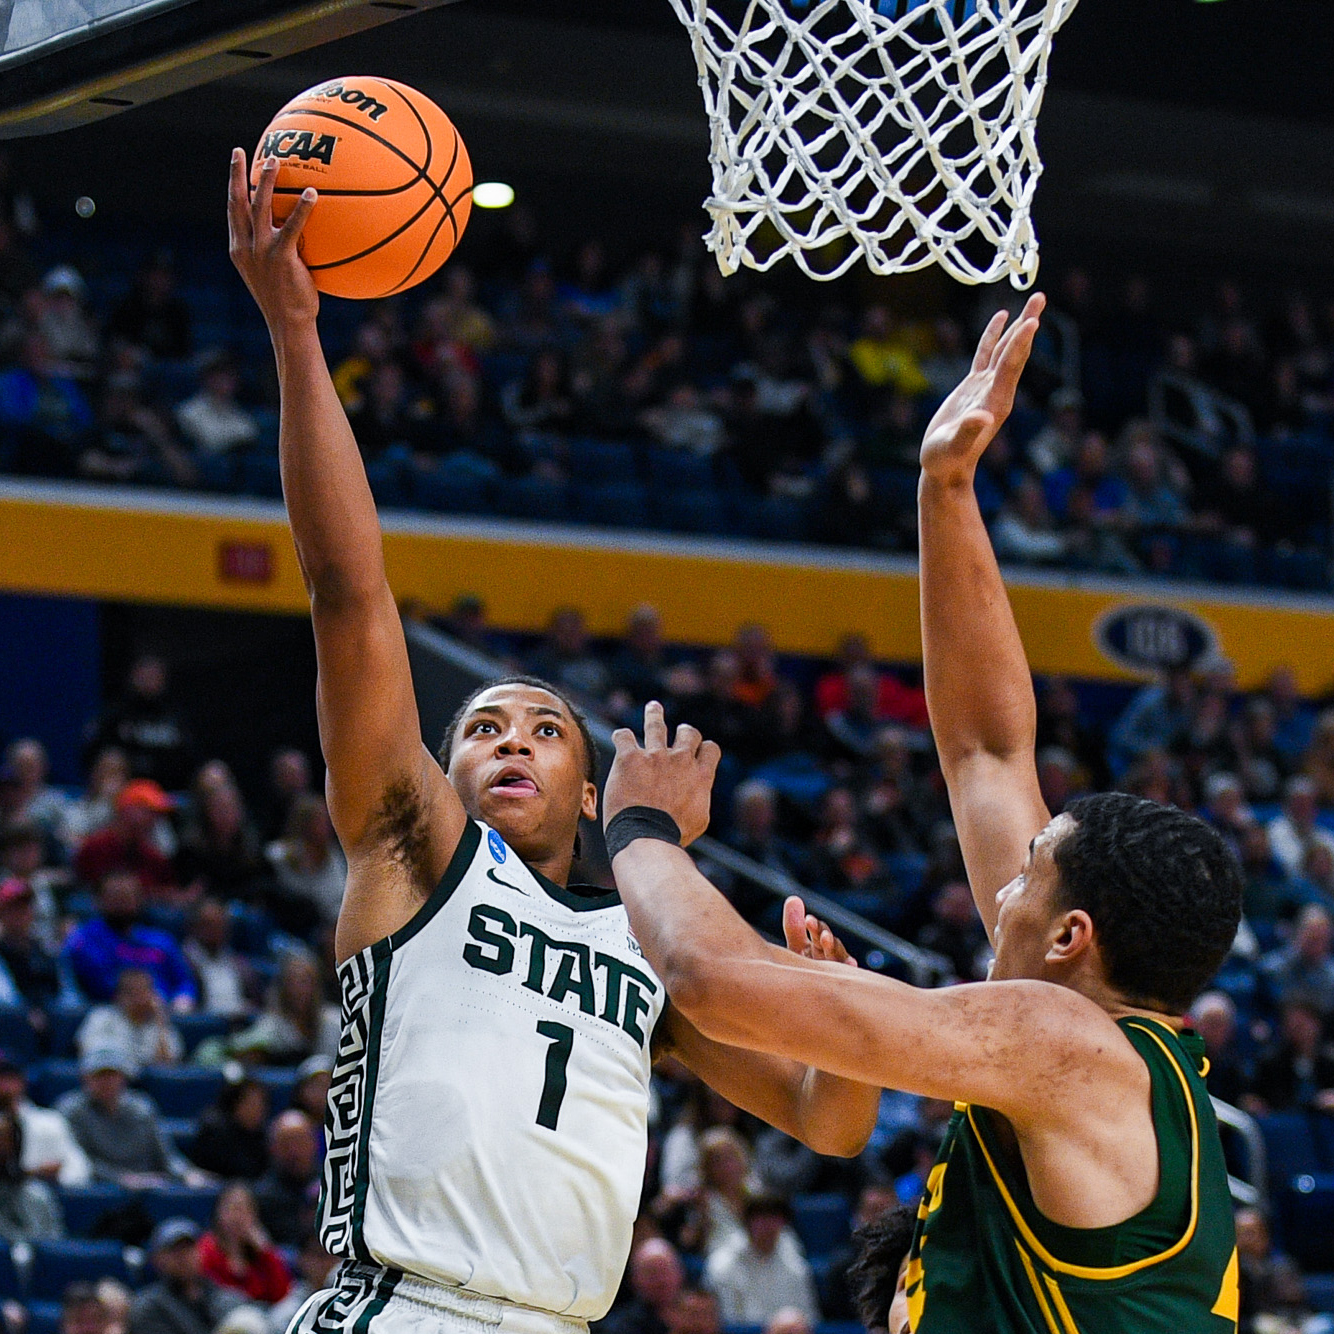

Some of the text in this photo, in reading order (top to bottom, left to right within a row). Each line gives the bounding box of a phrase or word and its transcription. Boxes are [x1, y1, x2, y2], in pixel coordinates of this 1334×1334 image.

[257, 129, 338, 165] NCAA
[302, 163, 328, 174] BALL
[463, 904, 657, 1050] STATE
[535, 1020, 574, 1131] 1
